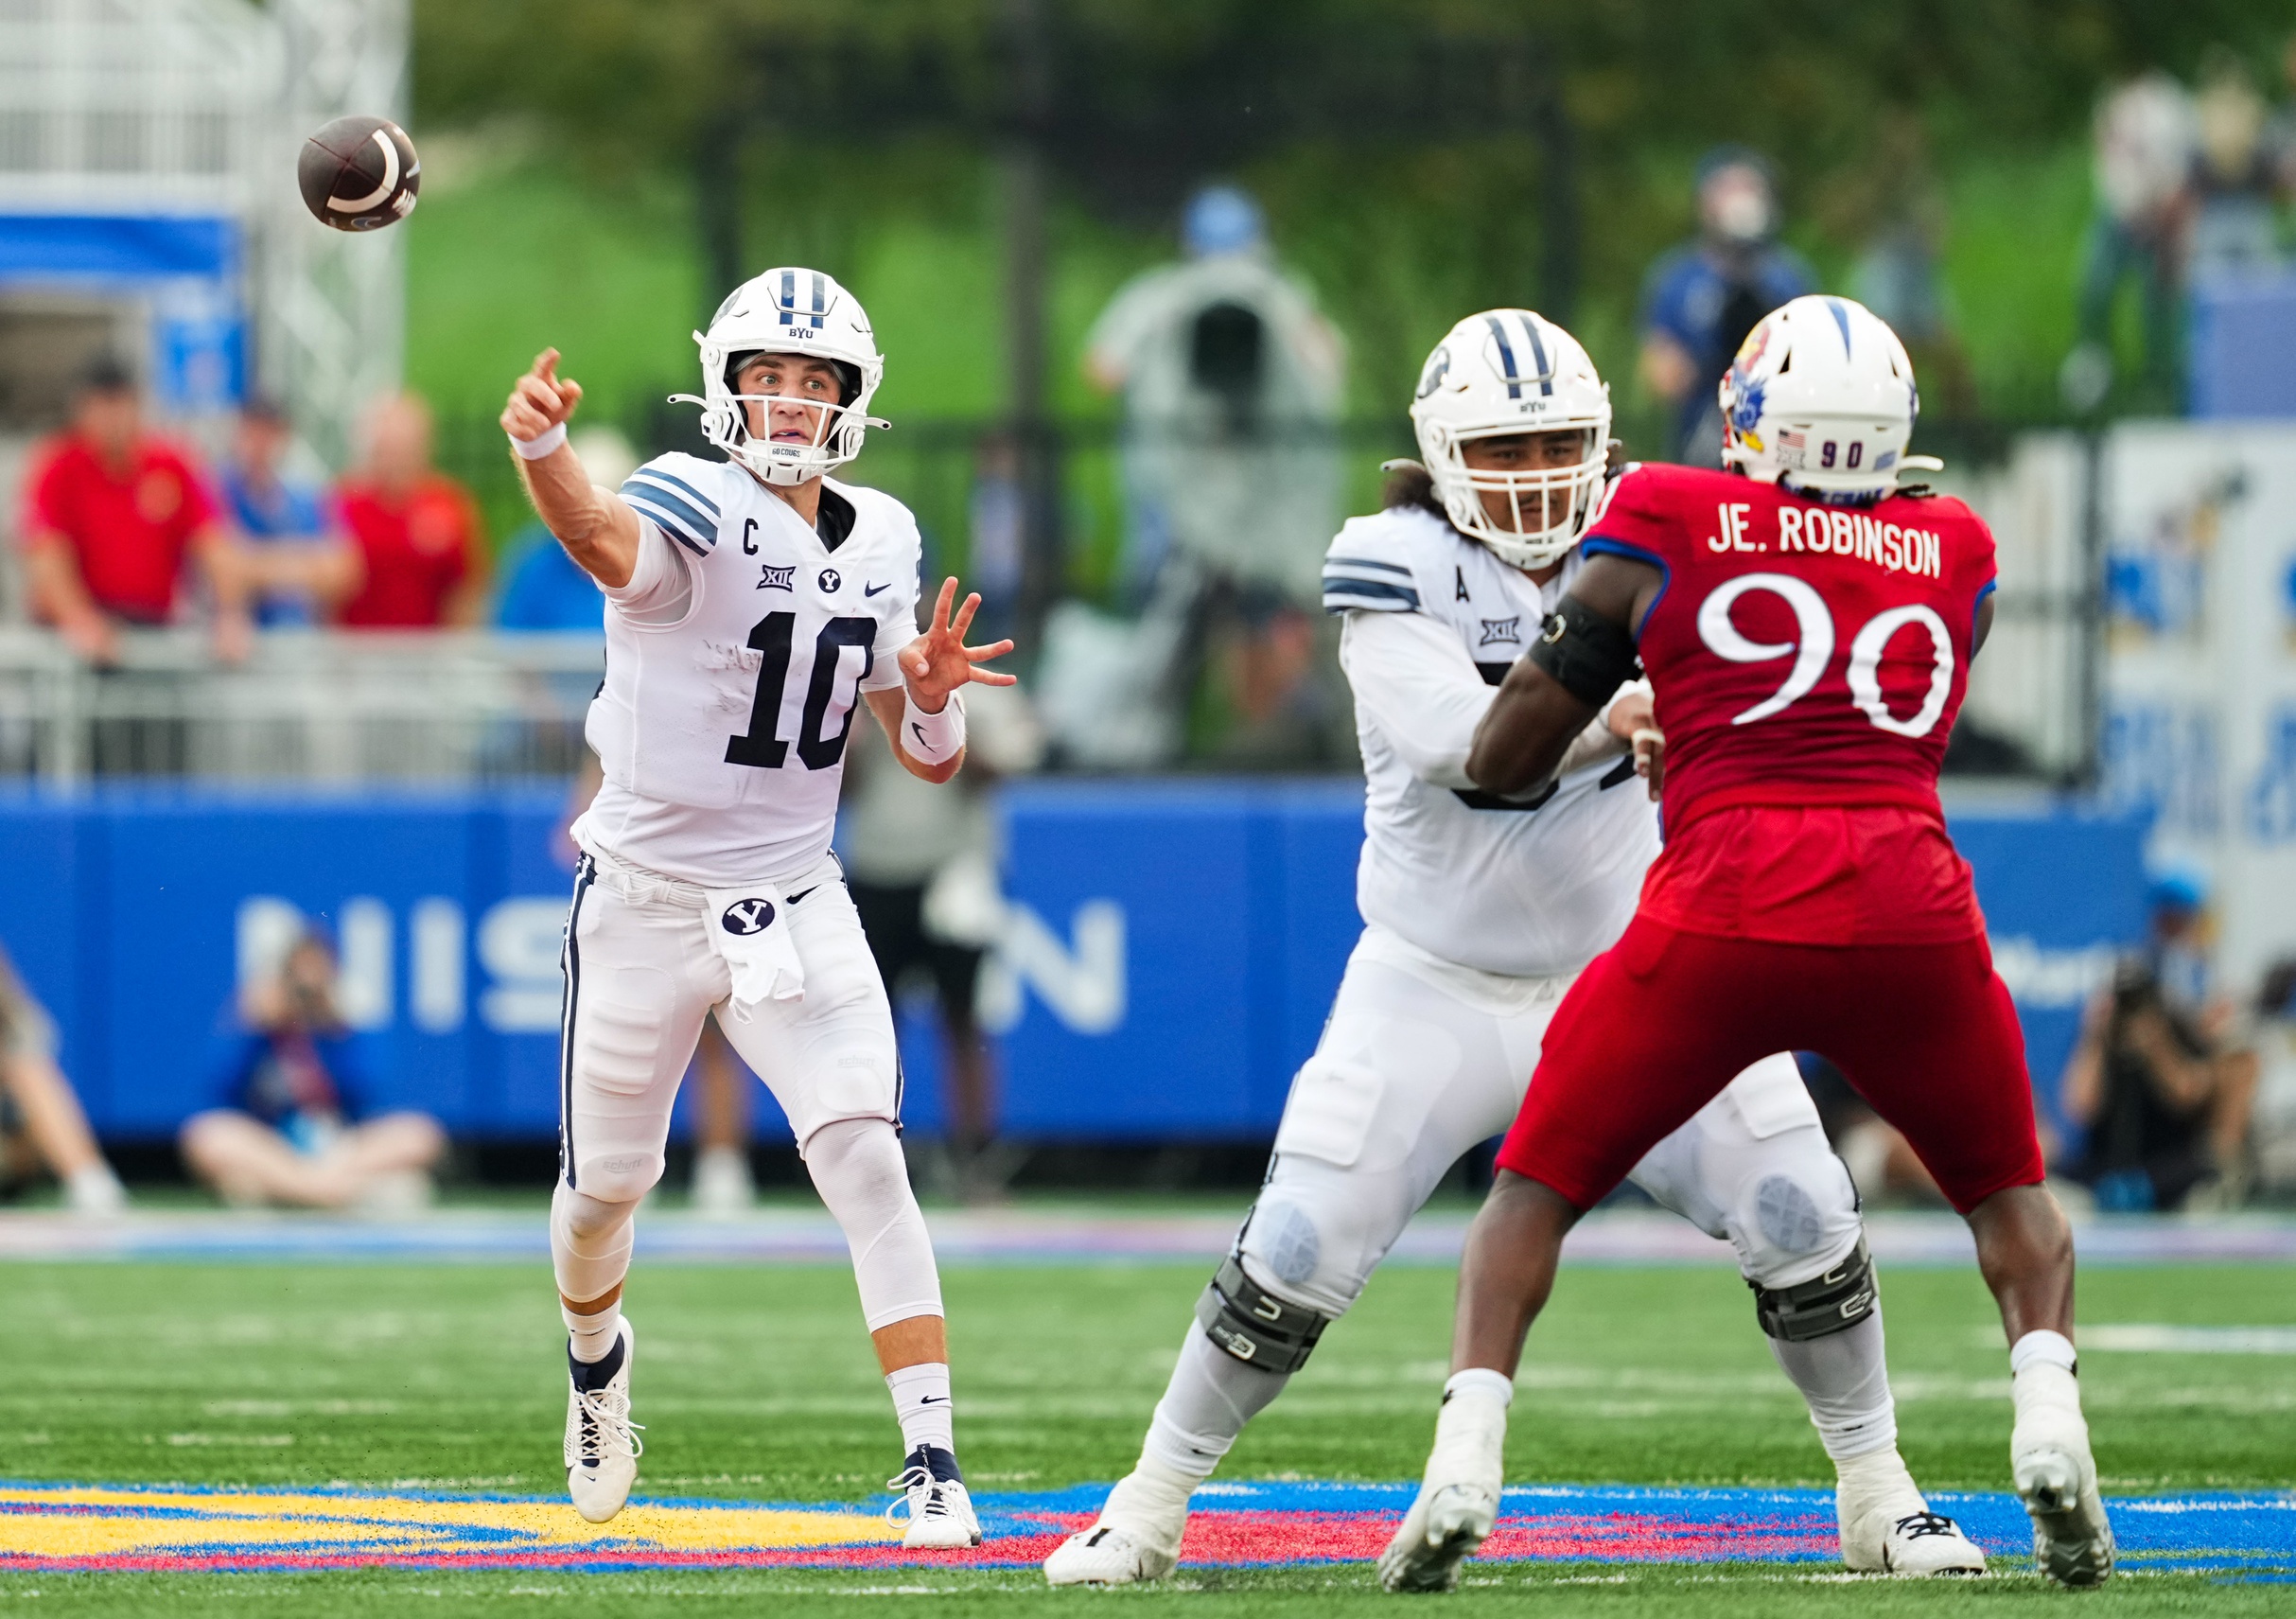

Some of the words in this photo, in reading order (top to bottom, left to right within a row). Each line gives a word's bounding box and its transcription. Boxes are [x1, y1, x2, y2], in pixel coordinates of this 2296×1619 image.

[789, 327, 814, 339] BYU
[1821, 440, 1863, 468] 90
[744, 518, 759, 555] C
[1708, 502, 1767, 553] JE.
[1778, 506, 1940, 579] ROBINSON
[1456, 565, 1470, 603] A
[1697, 572, 1954, 738] 90
[724, 611, 878, 770] 10
[726, 900, 768, 933] Y
